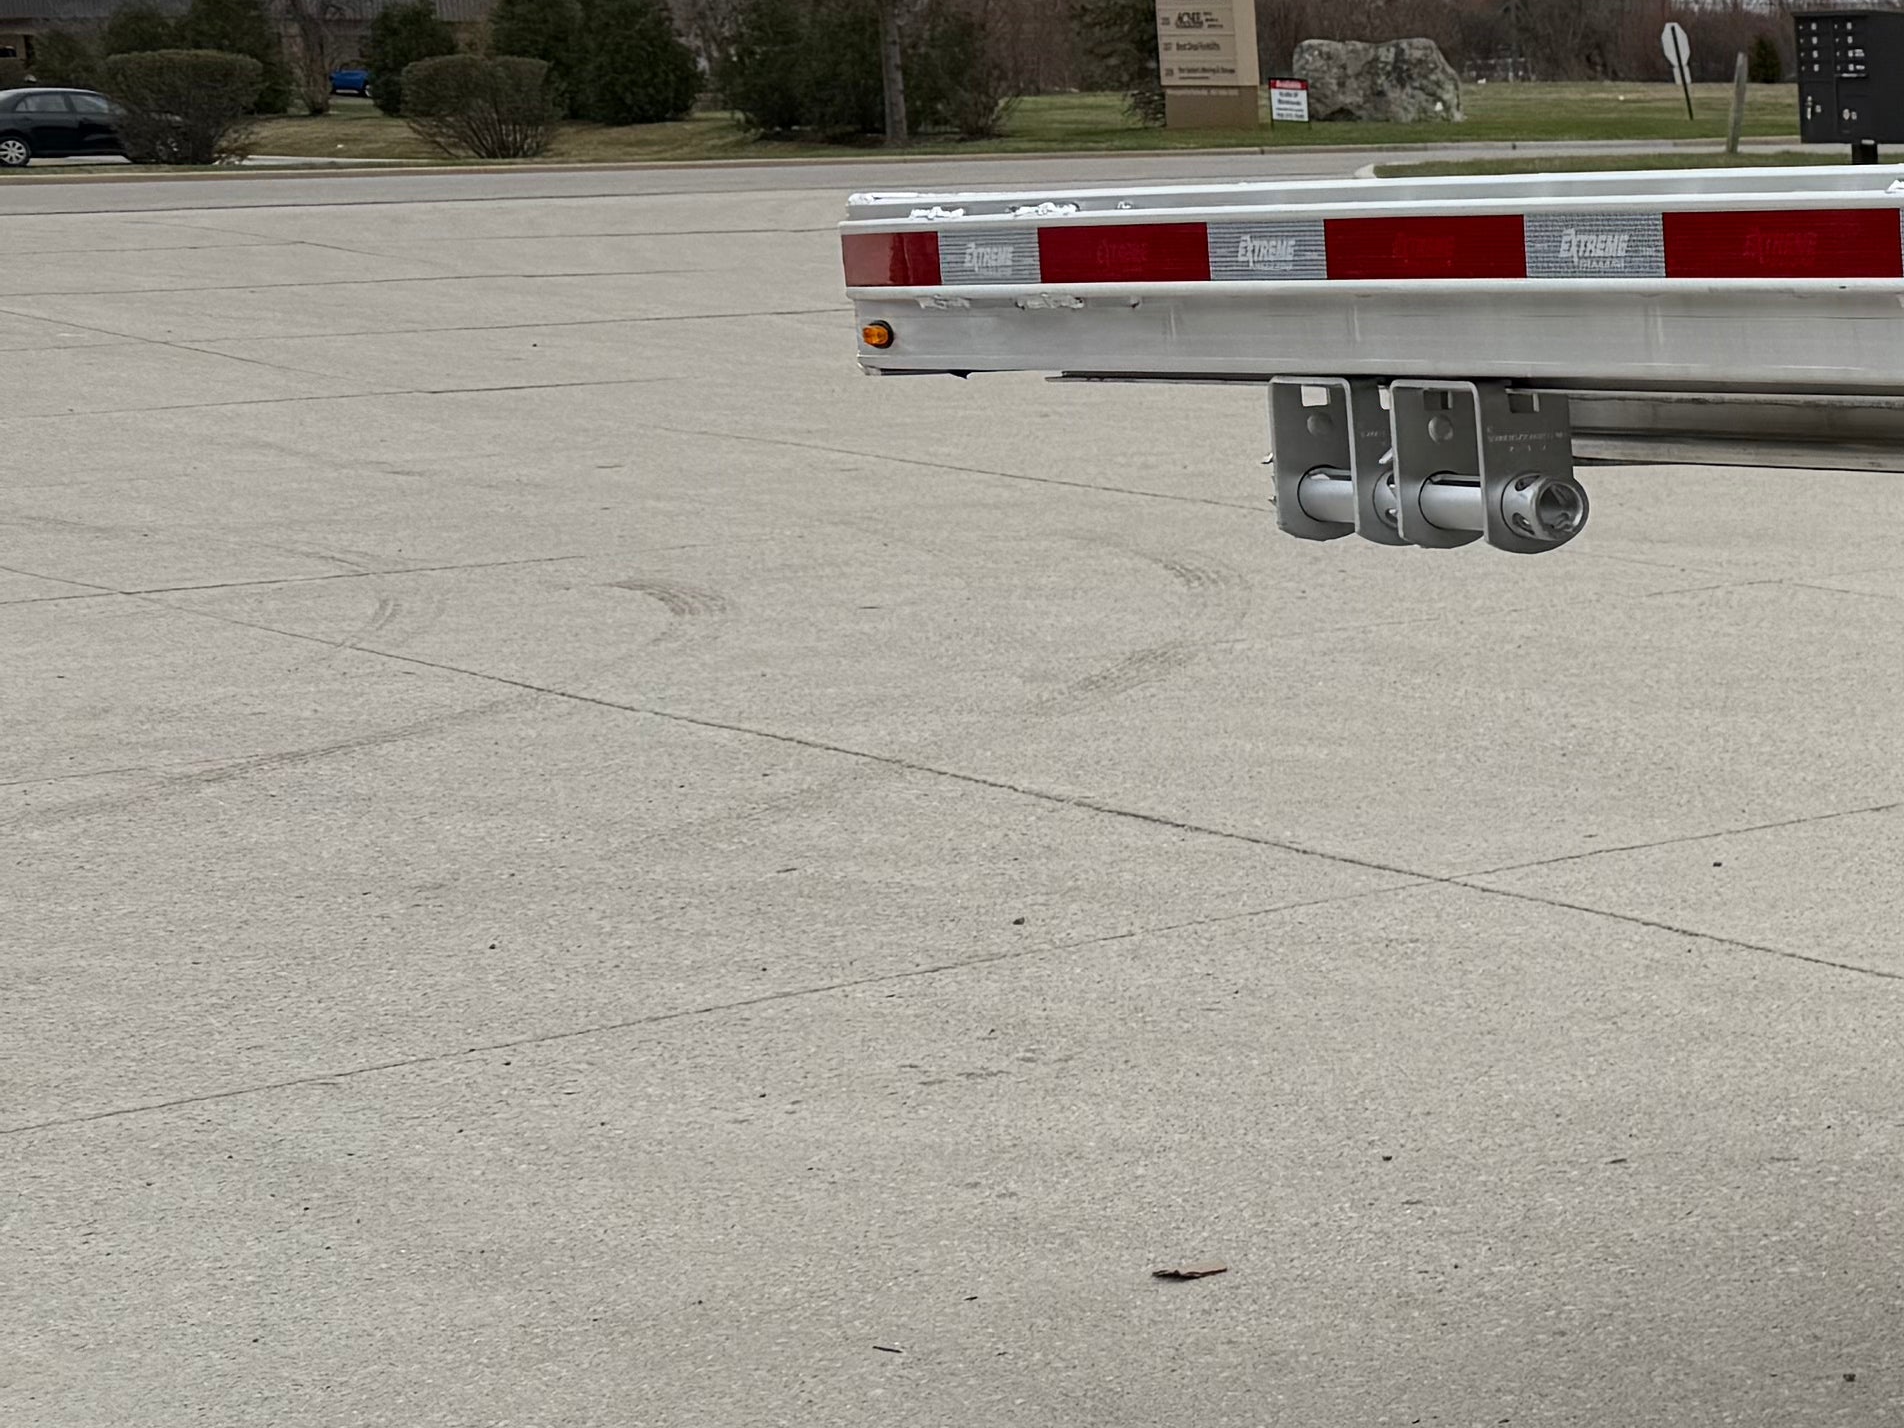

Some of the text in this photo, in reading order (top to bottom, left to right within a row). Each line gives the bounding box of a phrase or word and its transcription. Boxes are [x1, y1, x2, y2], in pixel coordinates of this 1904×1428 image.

[964, 241, 1015, 270] EXTREME
[1237, 233, 1296, 270] EXTREME
[1559, 227, 1633, 263] EXTREME
